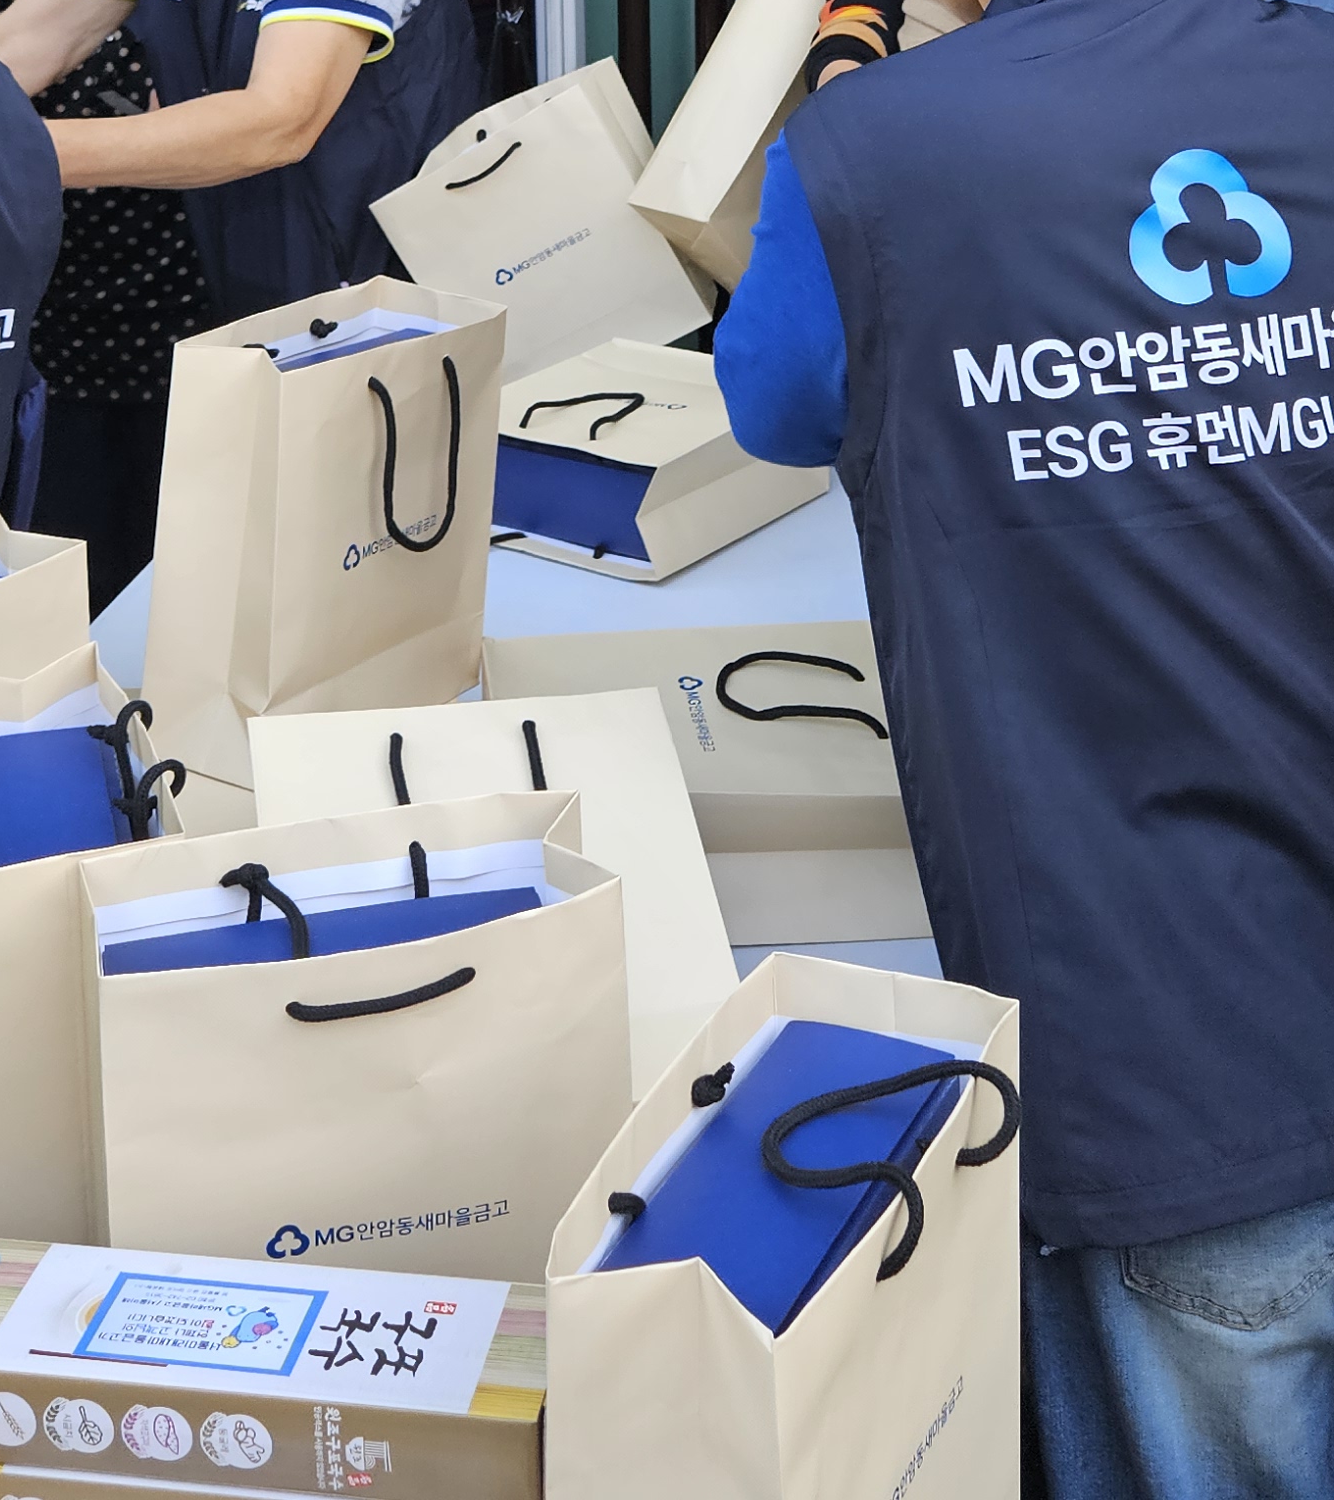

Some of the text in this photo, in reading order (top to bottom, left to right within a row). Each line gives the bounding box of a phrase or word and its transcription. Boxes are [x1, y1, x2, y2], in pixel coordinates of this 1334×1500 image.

[1006, 421, 1134, 482] ESG
[315, 1199, 510, 1247] MG안암동새마을금고
[63, 1413, 73, 1438] 시금치
[324, 1406, 344, 1491] 원조구포국수
